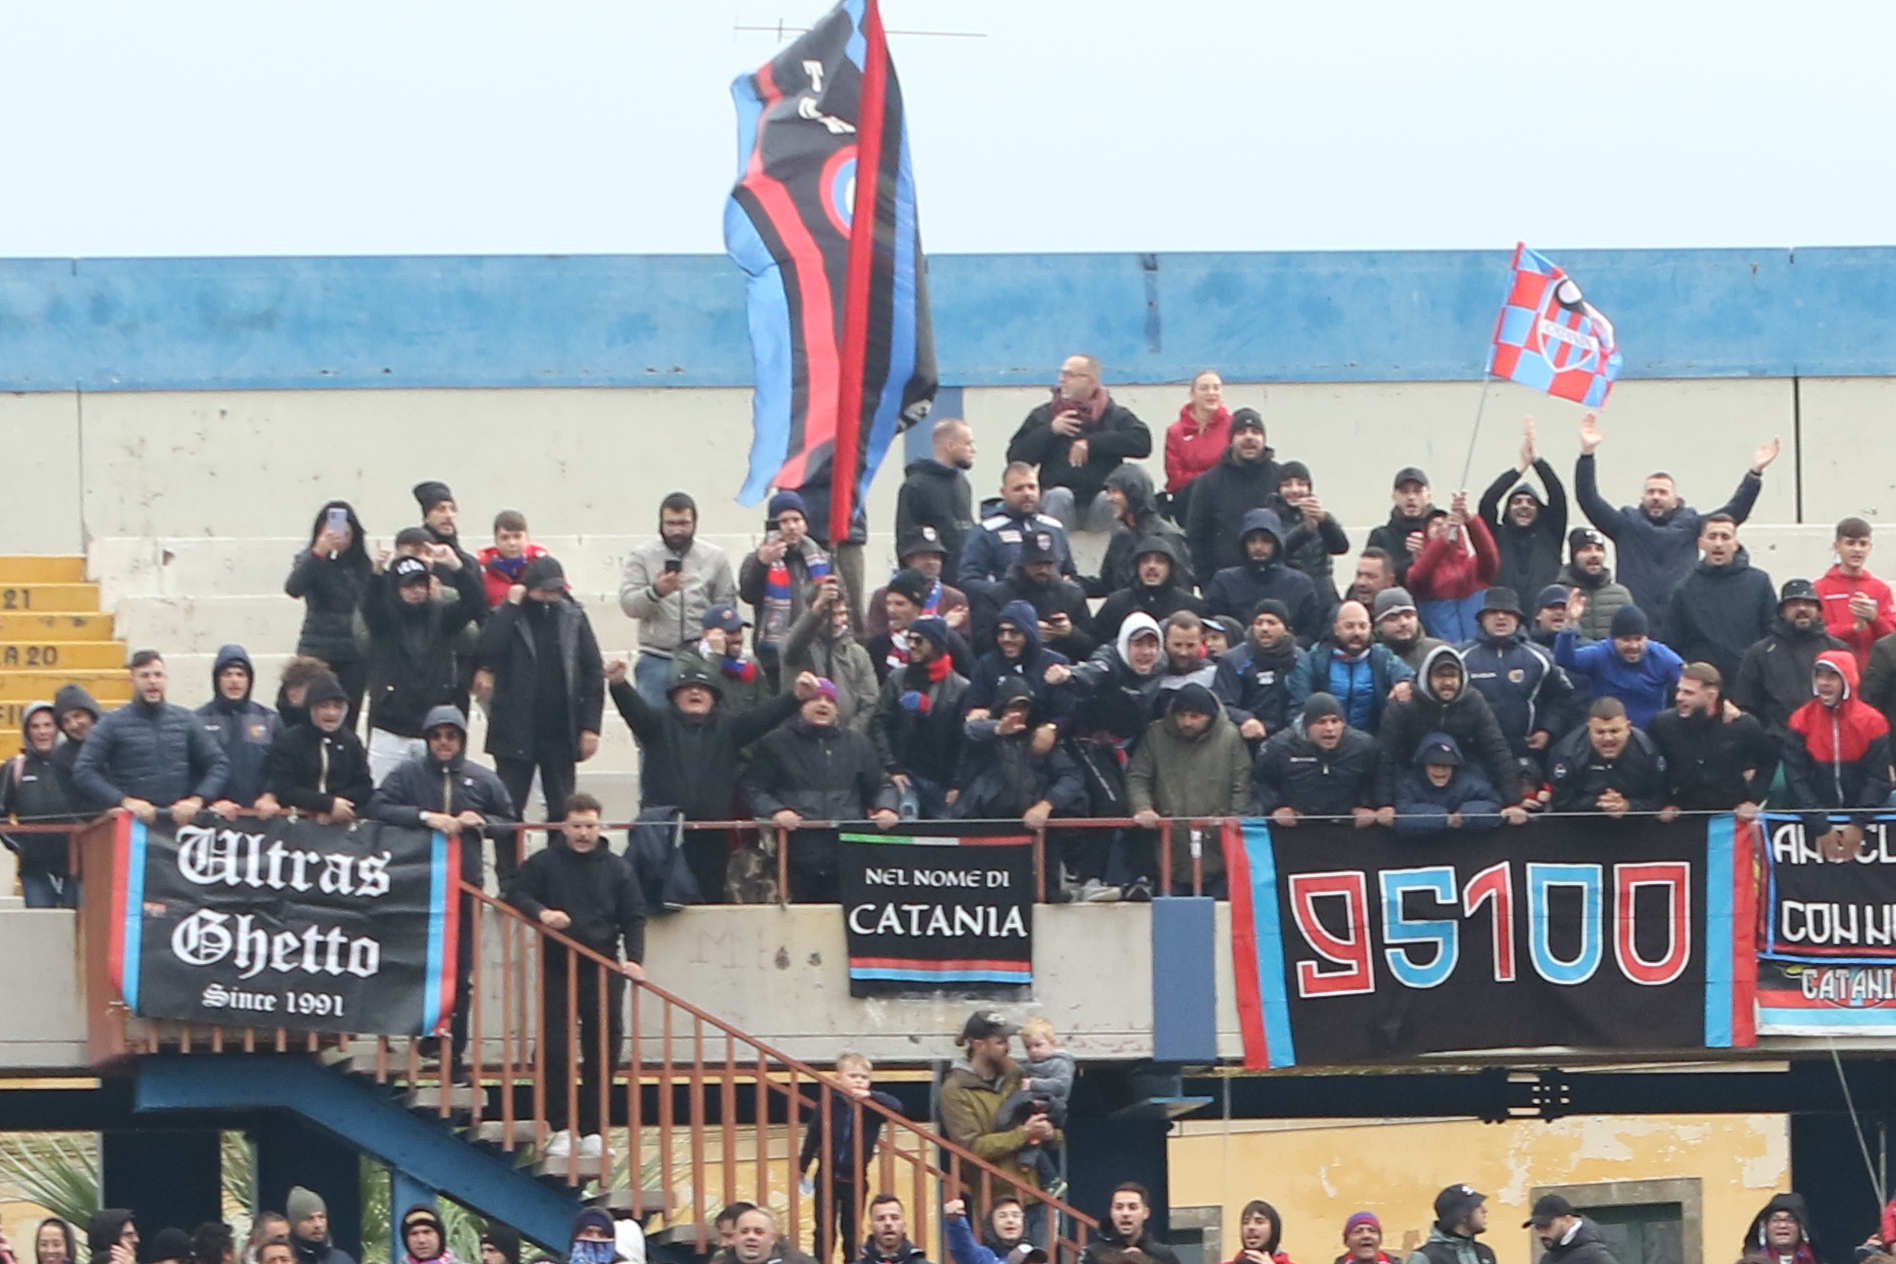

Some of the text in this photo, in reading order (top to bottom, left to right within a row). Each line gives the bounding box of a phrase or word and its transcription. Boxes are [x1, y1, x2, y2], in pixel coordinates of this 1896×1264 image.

[3, 589, 32, 609] 21
[27, 646, 58, 666] 20
[175, 825, 391, 896] Ultras
[865, 867, 1010, 888] NEL NOME DI
[849, 903, 1028, 937] CATANIA
[1288, 861, 1690, 998] 95100
[1782, 900, 1857, 945] CON
[171, 908, 381, 979] Ghetto
[201, 982, 345, 1017] Since 1991
